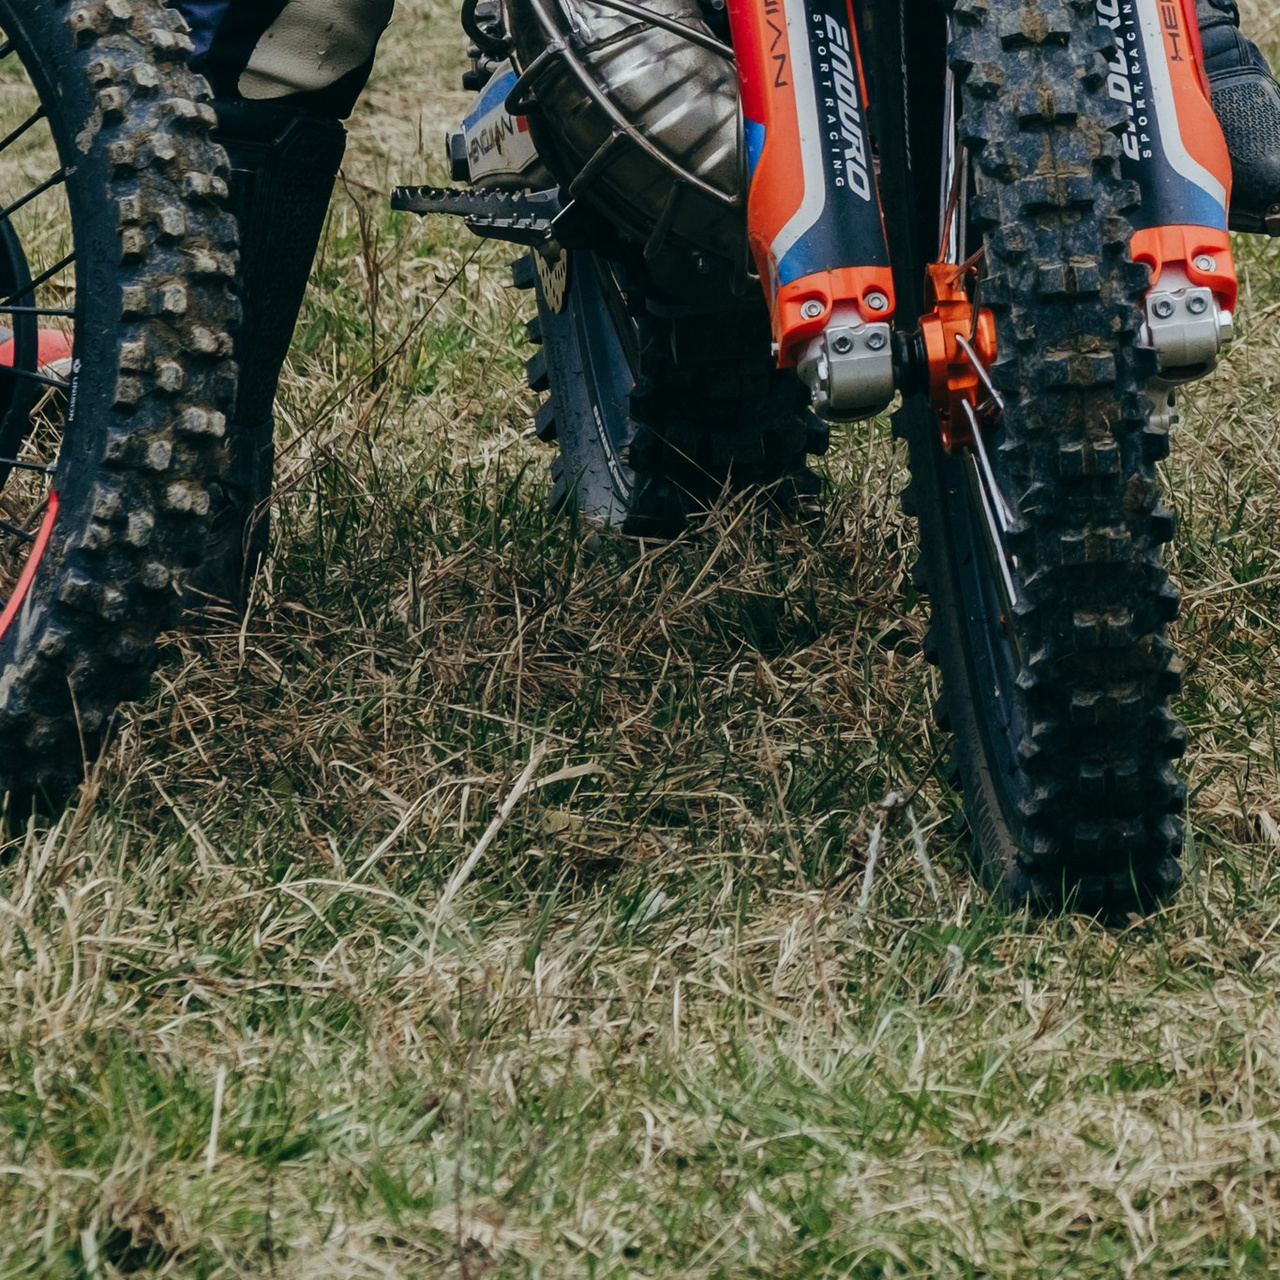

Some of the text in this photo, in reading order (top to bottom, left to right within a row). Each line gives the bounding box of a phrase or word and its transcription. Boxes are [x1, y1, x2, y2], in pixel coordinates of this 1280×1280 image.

[813, 14, 846, 188] SPORT RACING
[825, 13, 872, 202] ENDURO
